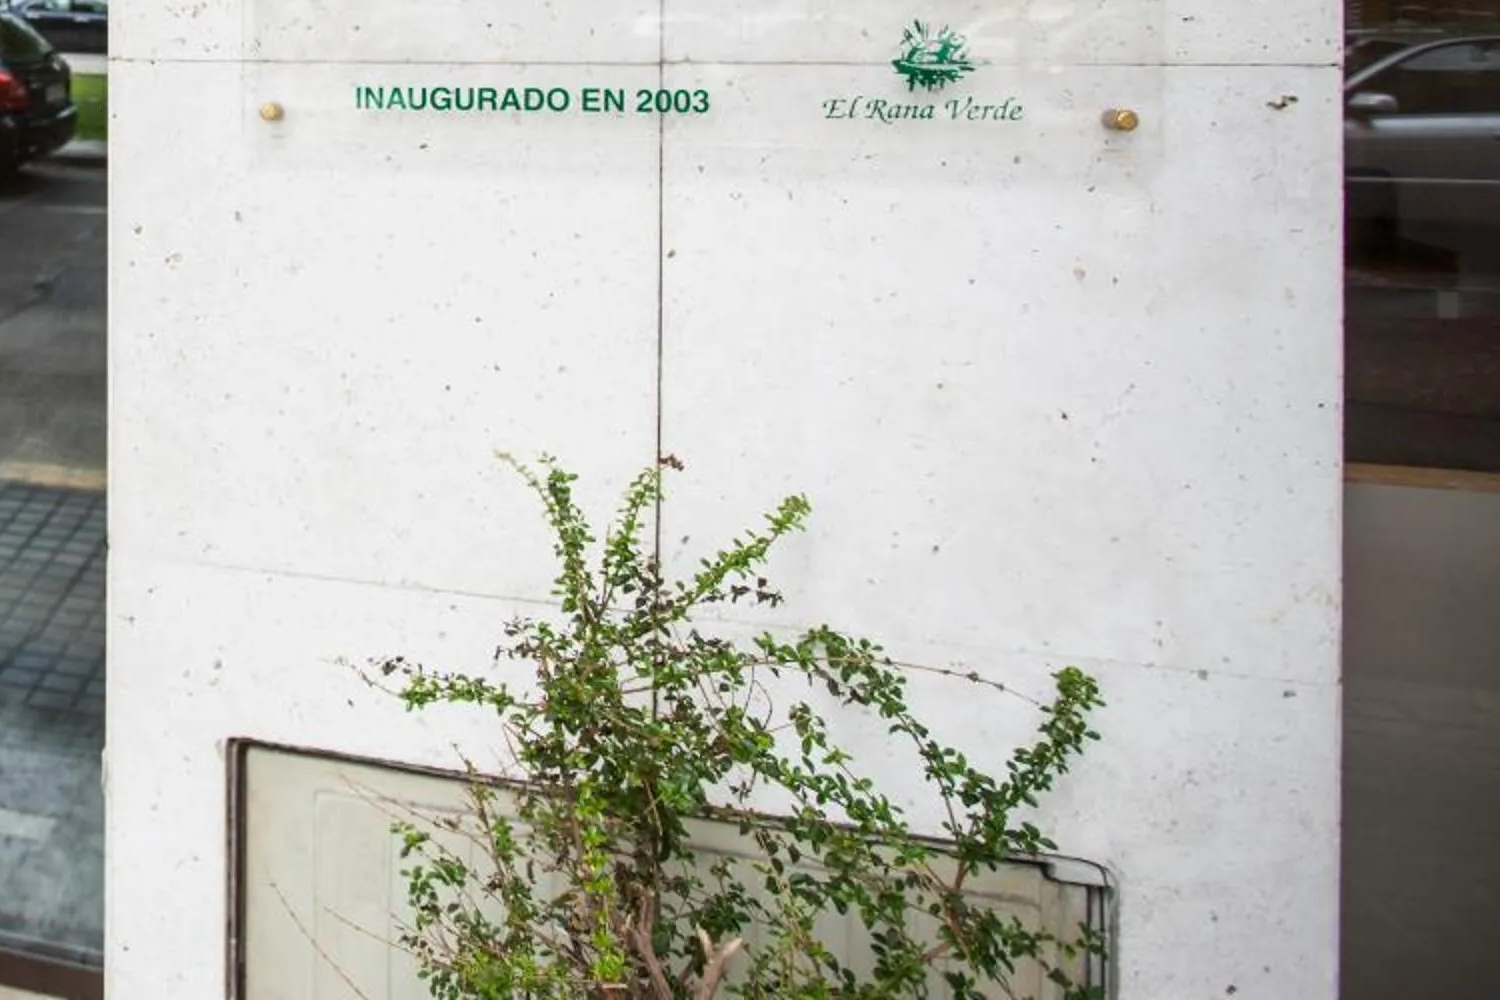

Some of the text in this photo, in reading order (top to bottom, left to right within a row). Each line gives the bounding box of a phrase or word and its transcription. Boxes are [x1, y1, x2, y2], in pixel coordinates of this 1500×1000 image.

[355, 86, 710, 115] INAUGURADO EN 2003
[822, 95, 1025, 124] El Rana Verde
